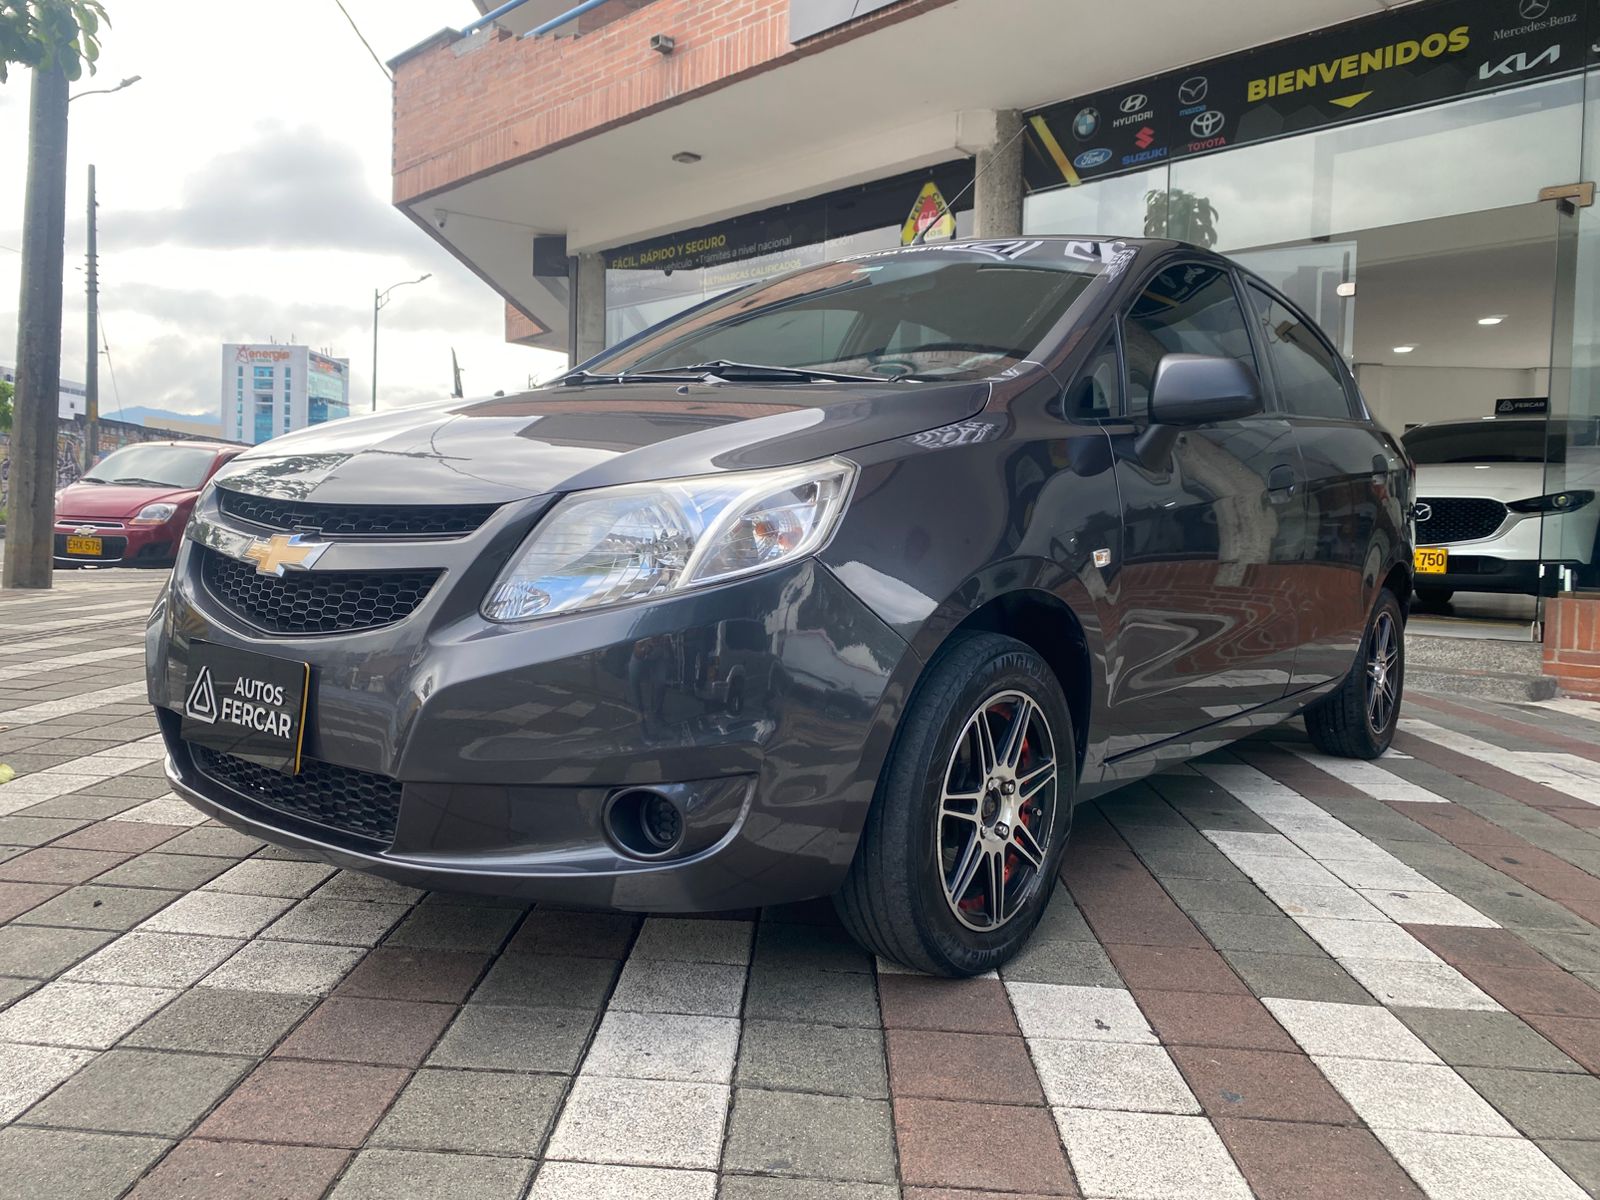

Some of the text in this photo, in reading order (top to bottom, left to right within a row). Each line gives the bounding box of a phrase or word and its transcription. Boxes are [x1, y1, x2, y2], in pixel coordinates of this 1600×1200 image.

[1493, 14, 1577, 40] Mercedes-Benz
[1247, 26, 1470, 102] BIENVENIDOS
[1479, 44, 1560, 80] KIA
[1113, 110, 1154, 128] HYUNDAI
[1122, 146, 1168, 165] SUZUKI
[1188, 137, 1226, 152] TOYOTA
[1080, 151, 1106, 166] Ford
[640, 246, 675, 265] RÁPIDO
[677, 244, 684, 256] Y
[685, 234, 726, 254] SEGURO
[738, 243, 756, 257] nivel
[758, 235, 792, 253] nacional
[1419, 552, 1445, 567] 750
[234, 676, 284, 707] AUTOS
[221, 697, 292, 739] FERCAR
